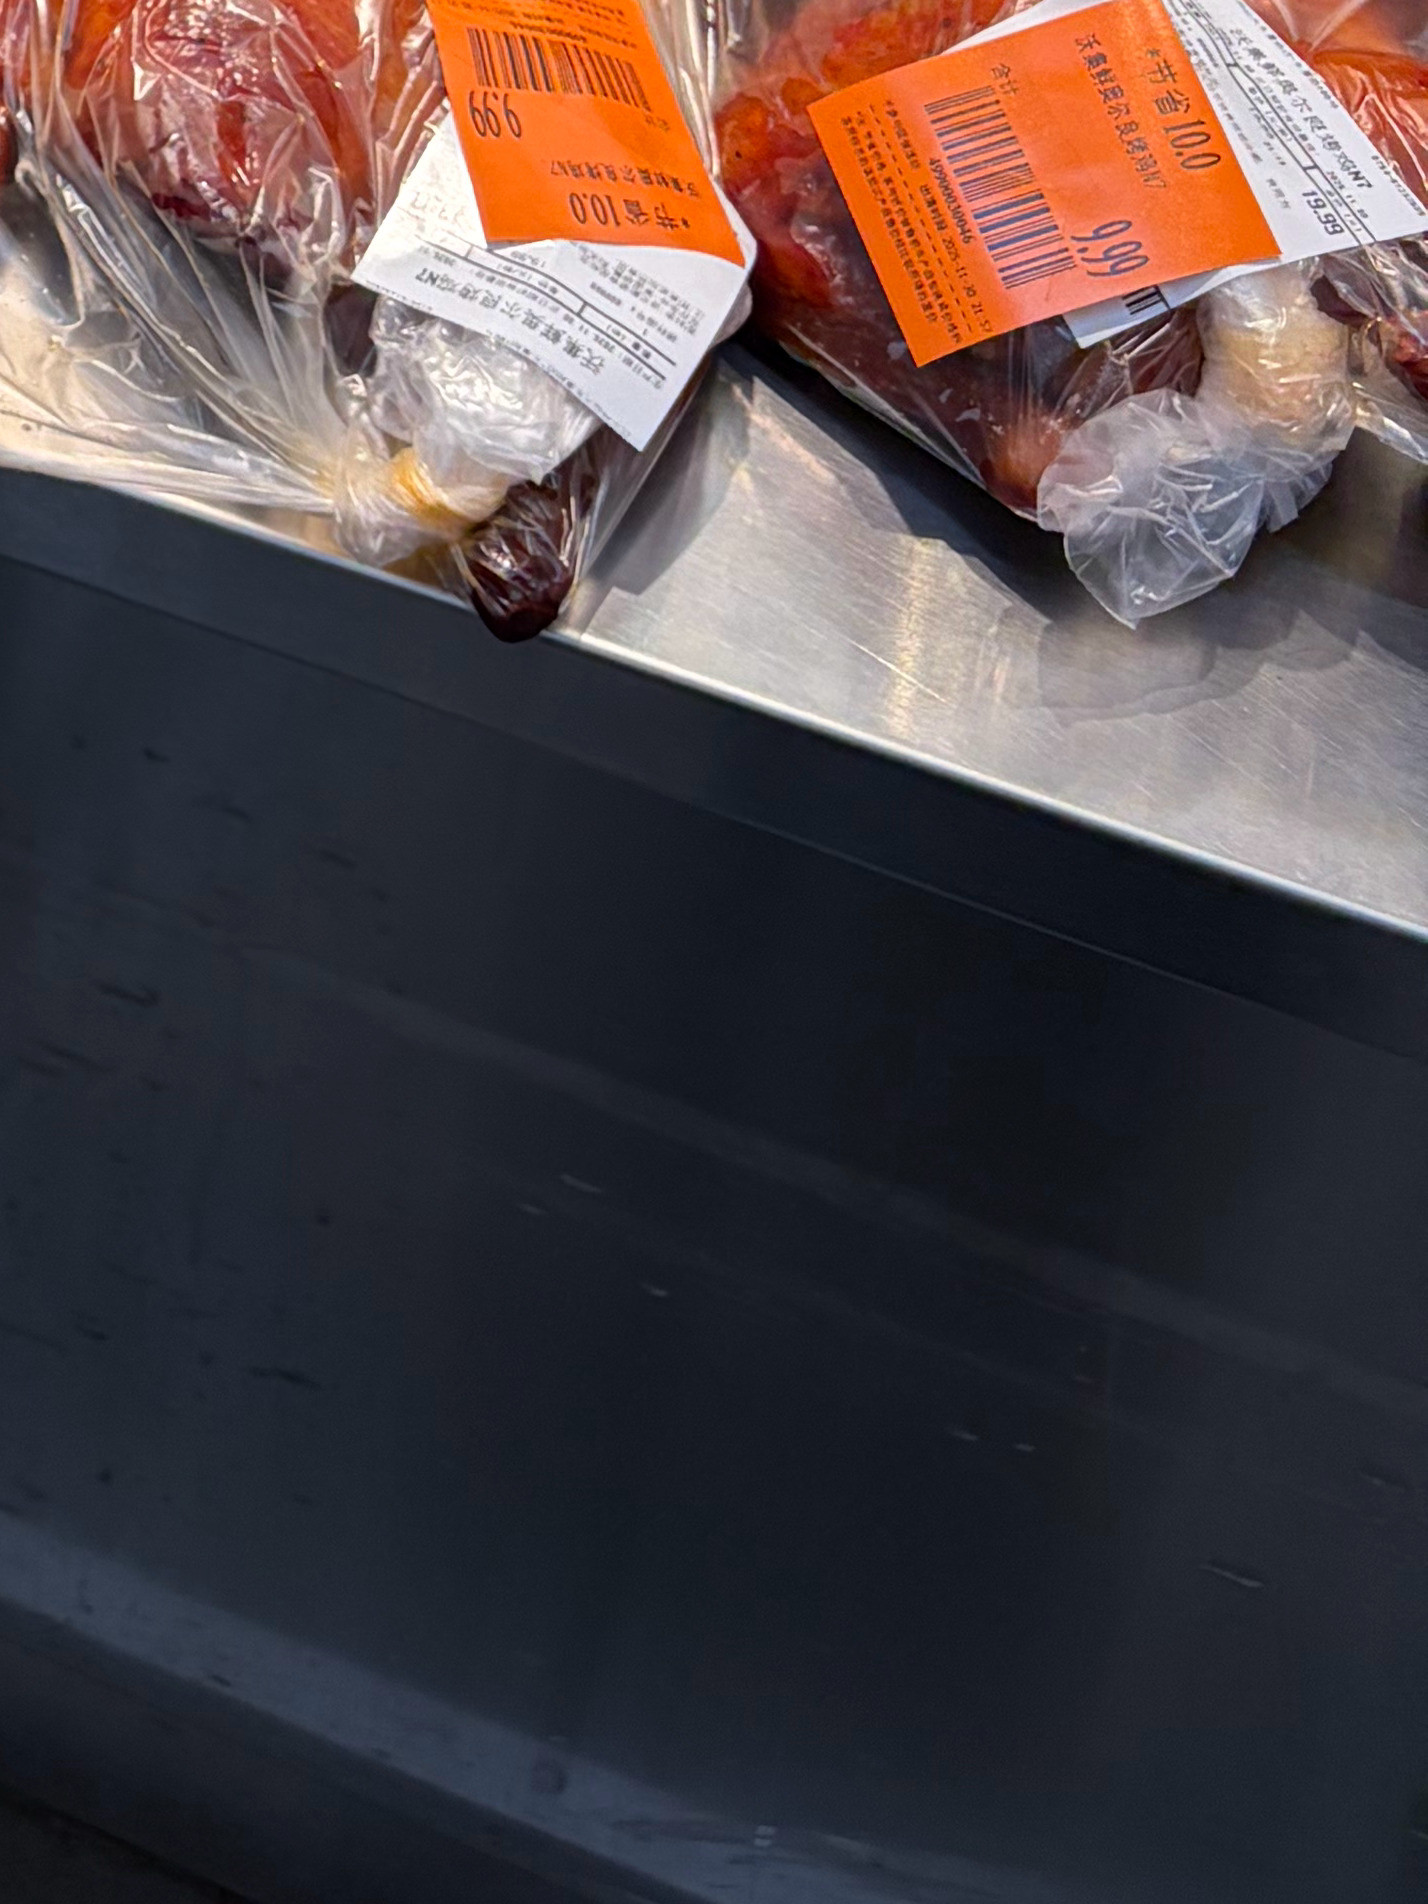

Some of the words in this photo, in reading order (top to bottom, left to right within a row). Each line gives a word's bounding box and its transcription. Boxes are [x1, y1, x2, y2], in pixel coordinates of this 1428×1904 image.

[469, 91, 522, 138] 9.99
[1303, 191, 1344, 235] 19.99
[1072, 220, 1148, 277] 9.99
